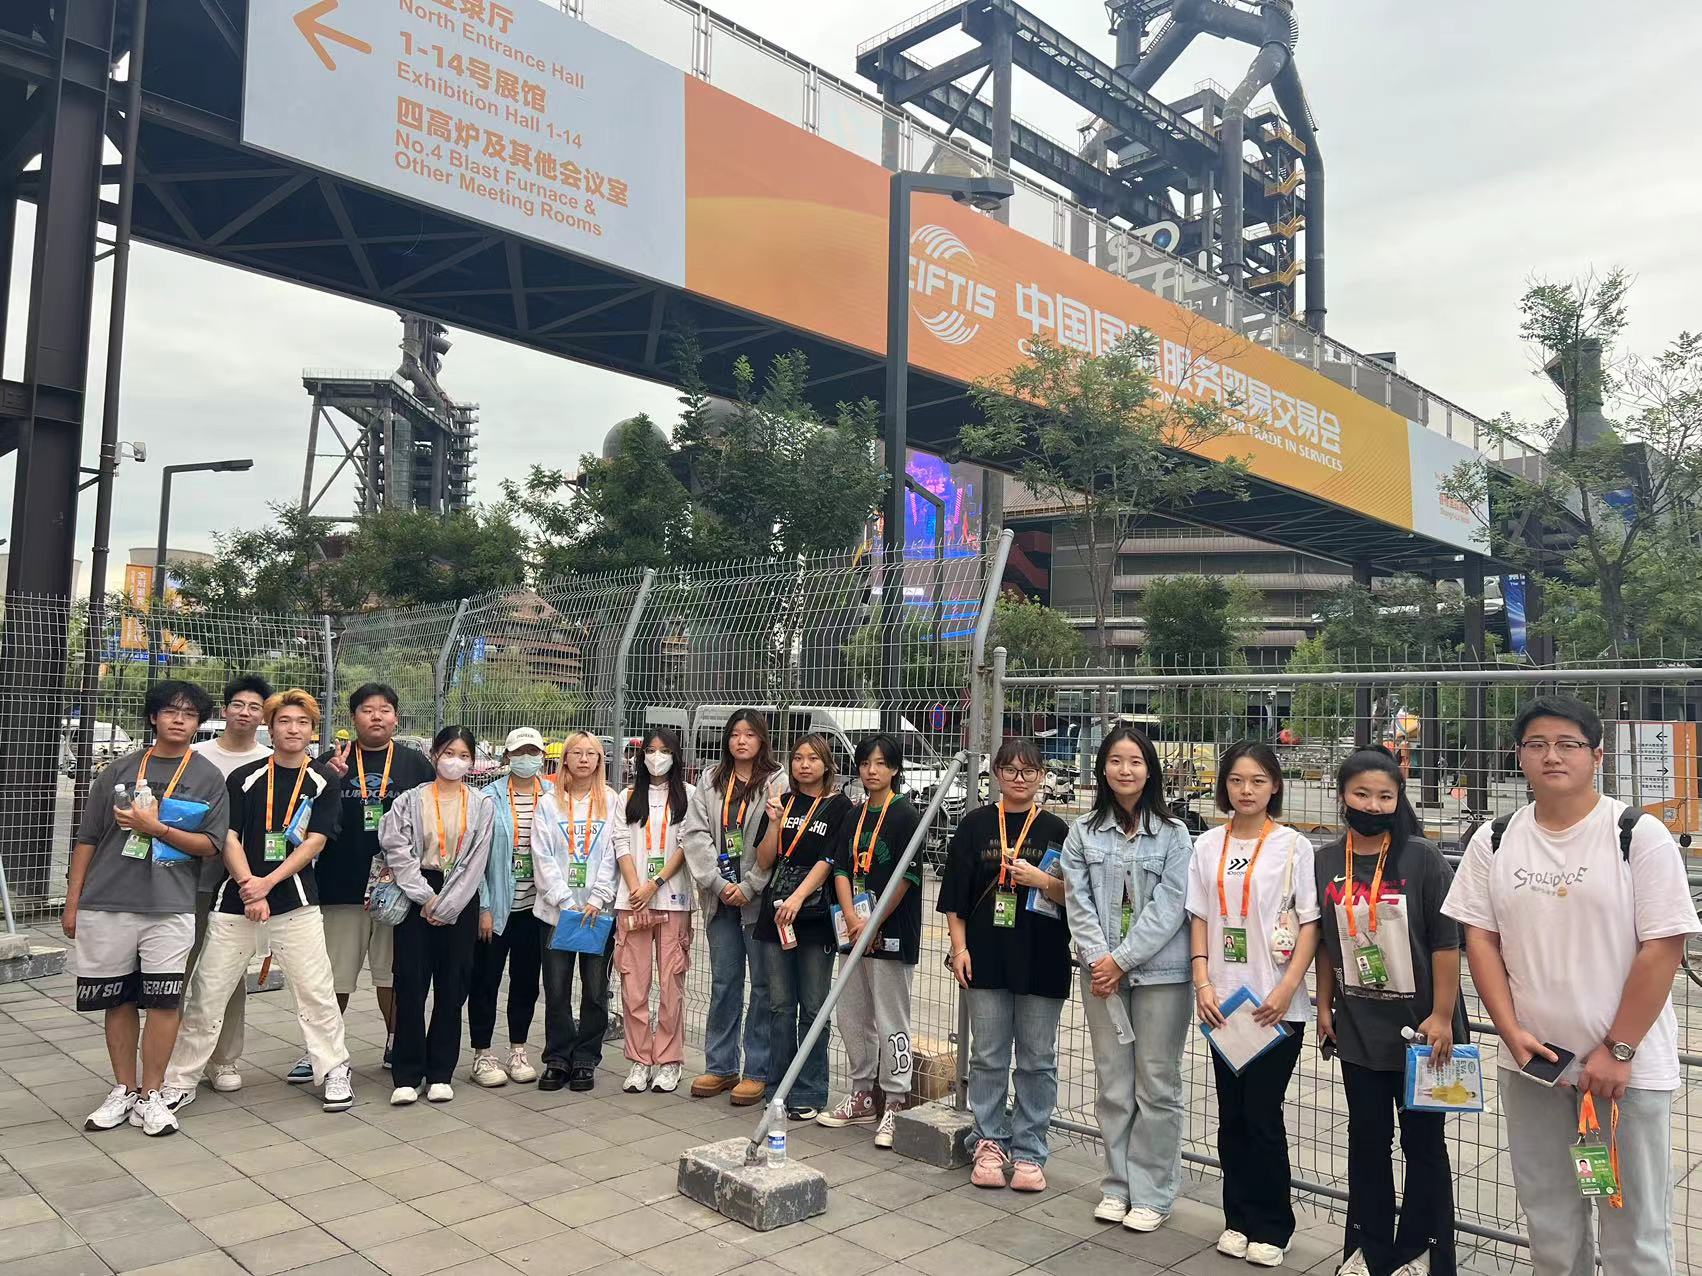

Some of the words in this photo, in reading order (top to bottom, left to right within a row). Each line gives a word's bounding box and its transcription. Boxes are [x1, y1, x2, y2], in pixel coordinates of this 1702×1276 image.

[399, 0, 455, 32] North
[462, 22, 545, 72] Entrance
[551, 62, 584, 89] Hall
[399, 31, 546, 114] 1-14号展馆
[397, 60, 498, 116] Exhibition
[505, 105, 540, 132] Hall
[546, 122, 582, 149] 1-14
[394, 151, 452, 184] Other
[459, 172, 534, 217] Meeting
[540, 199, 602, 237] Rooms
[395, 129, 442, 160] No.4
[449, 150, 500, 182] Blast
[505, 170, 578, 209] Furnace
[583, 199, 597, 216] &
[397, 95, 629, 208] 四高炉及其他会议室
[1016, 282, 1342, 454] 中国国服务贸易交易会
[1285, 439, 1297, 453] IN
[1299, 444, 1343, 472] SERVICES
[566, 824, 598, 835] UES
[102, 982, 123, 997] SO
[143, 980, 183, 995] SERIOU
[888, 1031, 912, 1075] B
